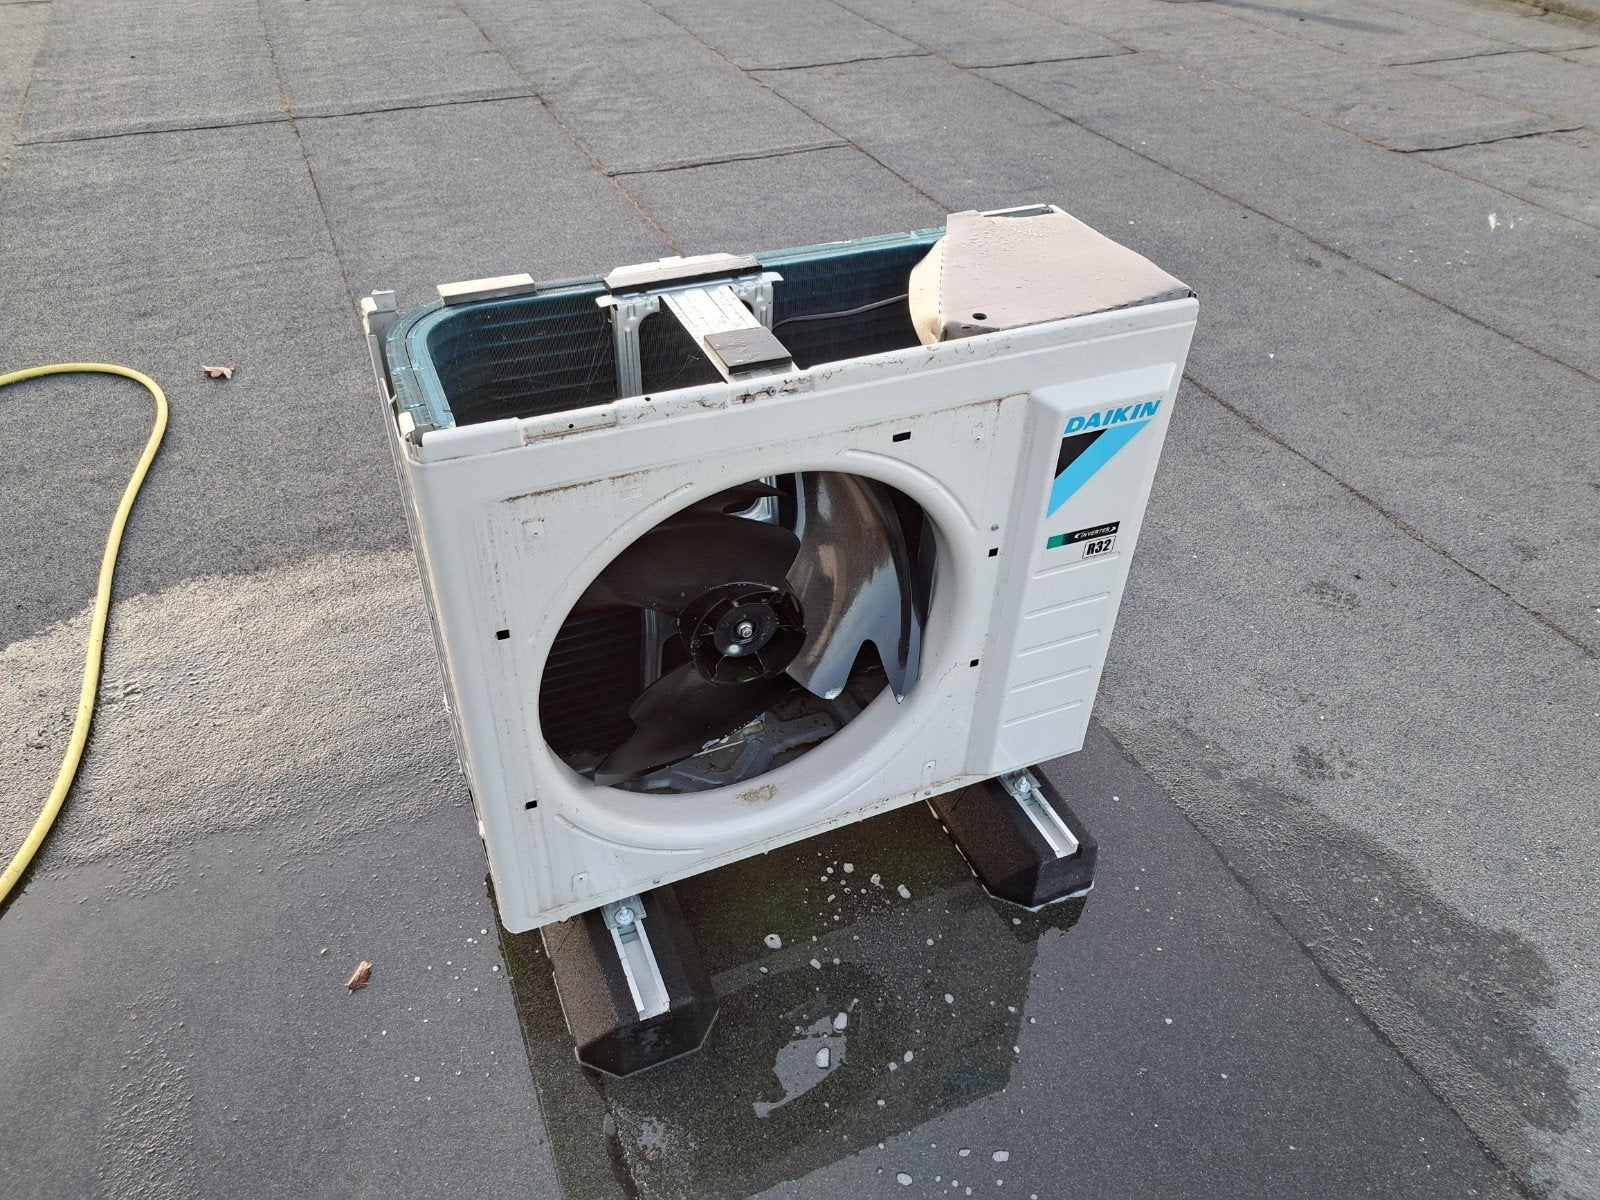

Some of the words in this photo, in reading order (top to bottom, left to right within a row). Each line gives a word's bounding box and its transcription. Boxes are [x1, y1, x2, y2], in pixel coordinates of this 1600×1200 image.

[1064, 400, 1161, 434] DAIKIN
[1080, 526, 1111, 538] INVERTER
[1086, 539, 1112, 555] R32
